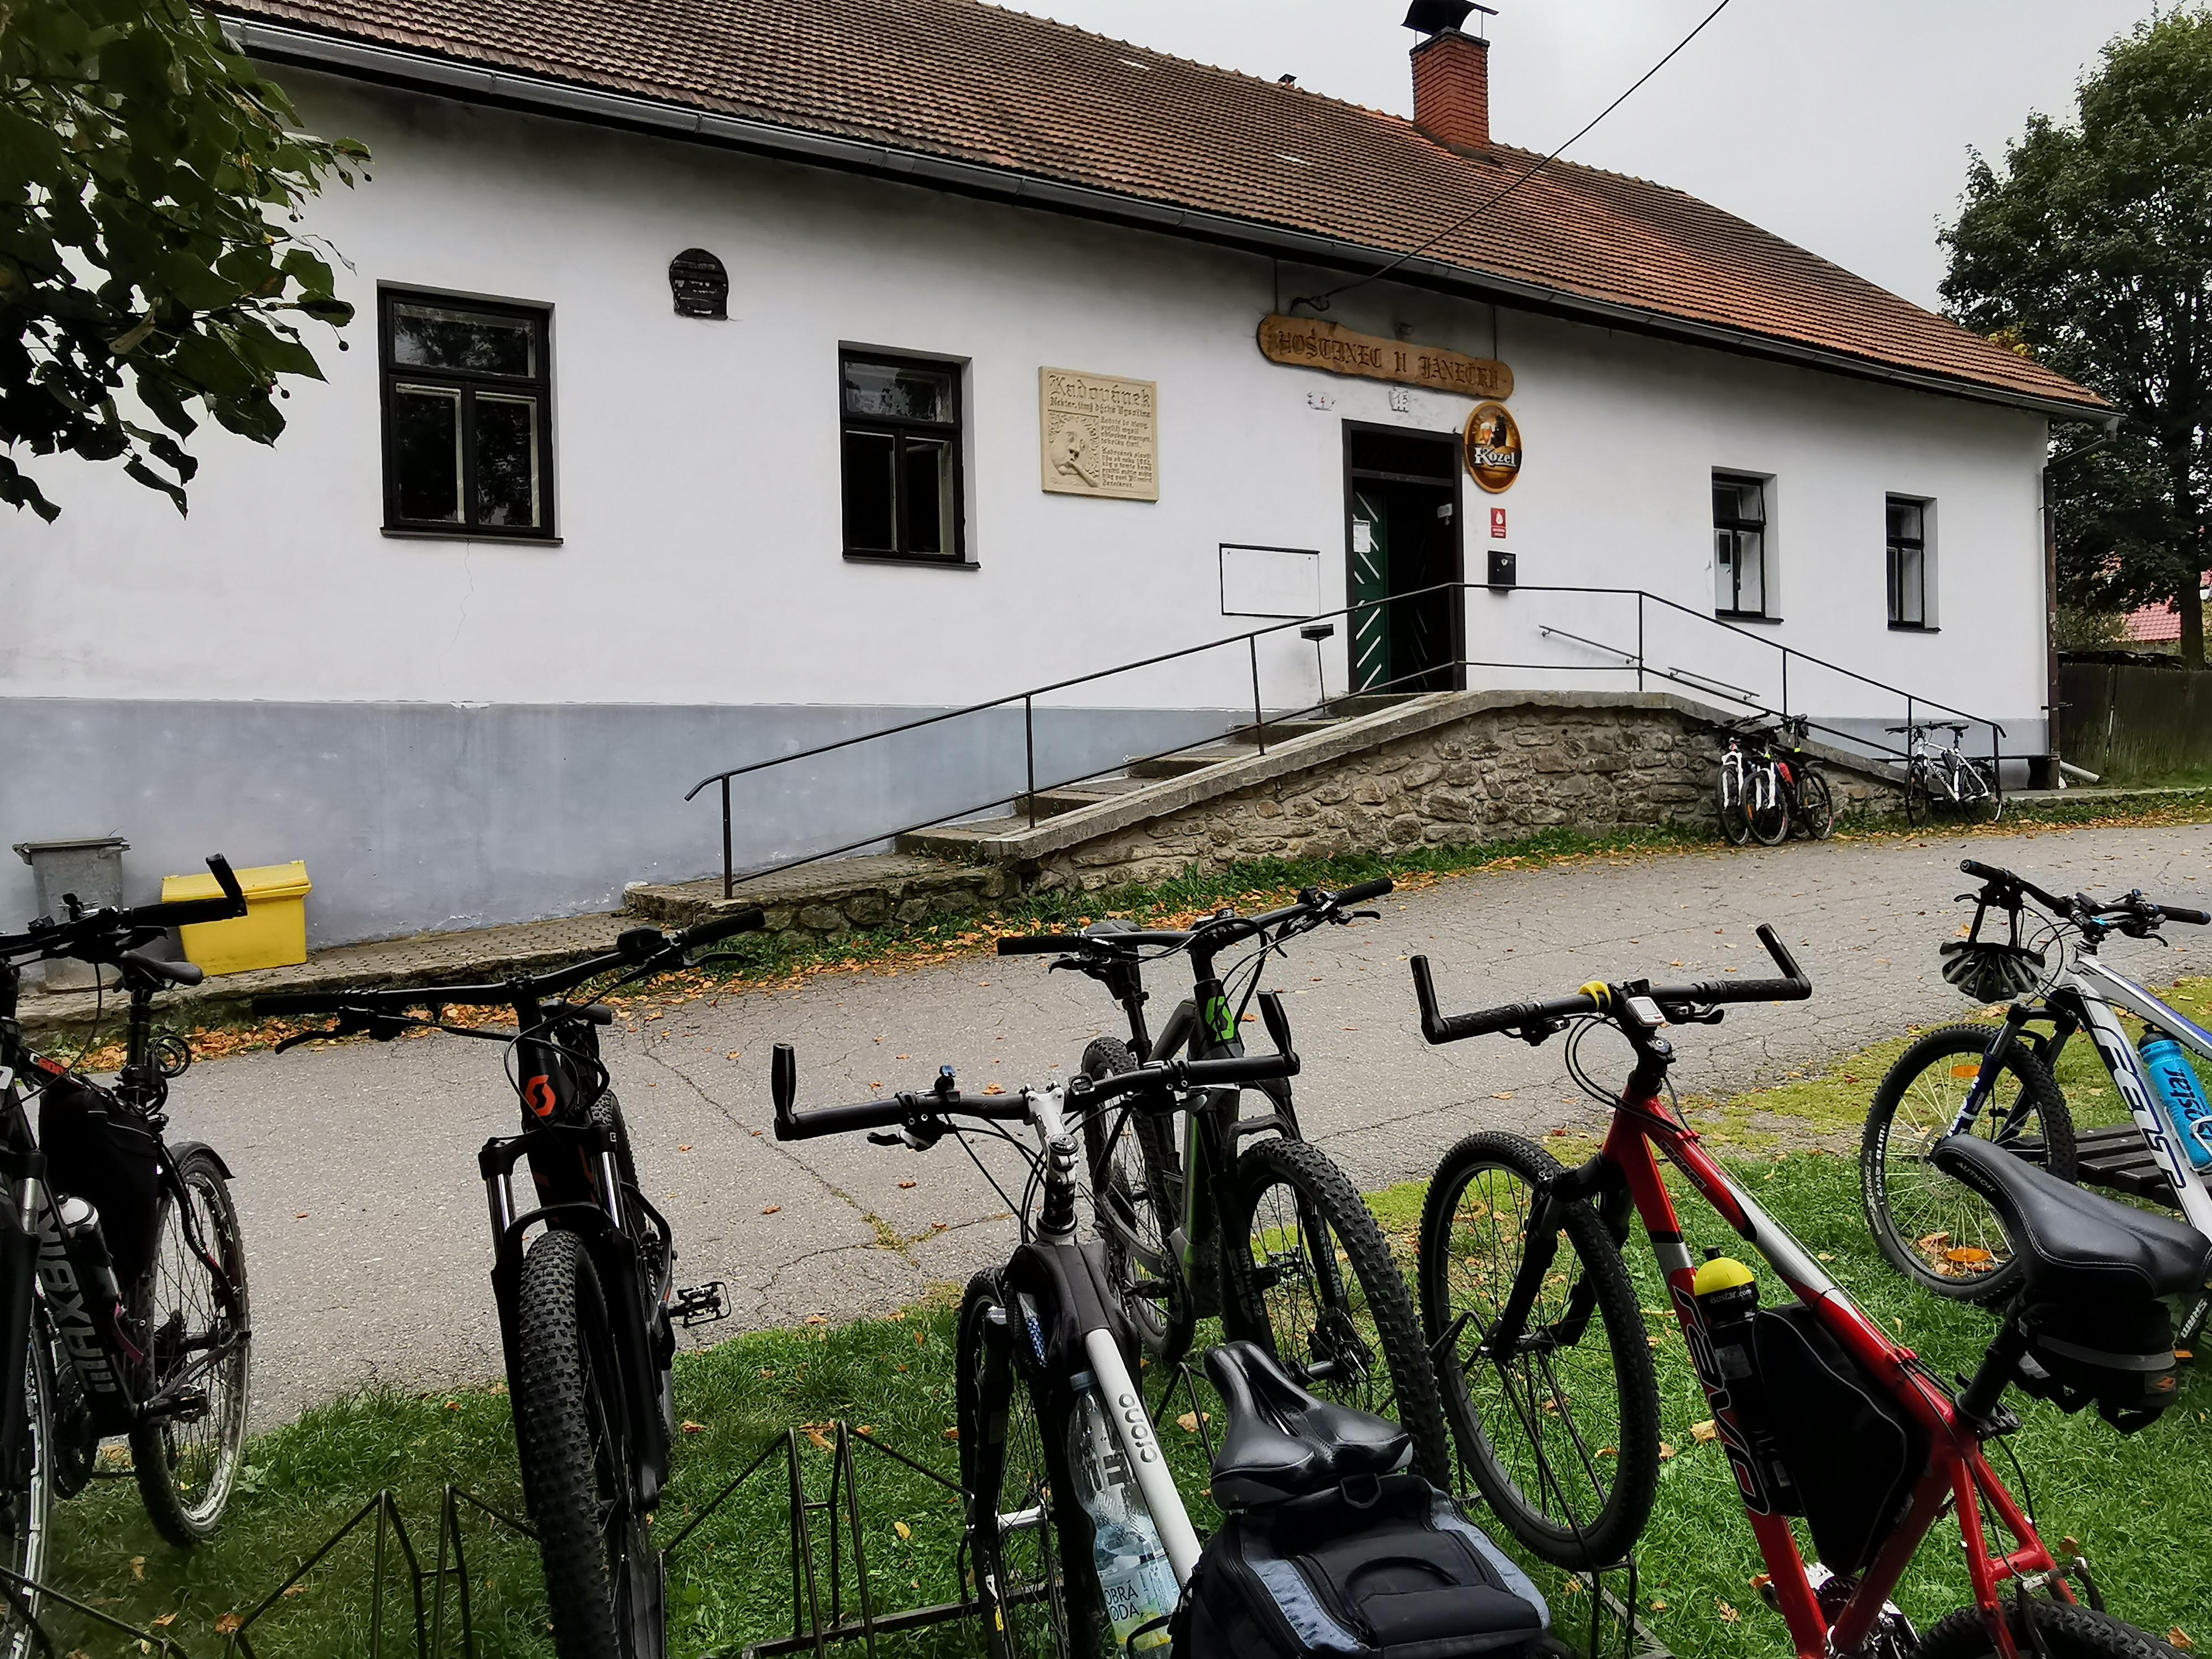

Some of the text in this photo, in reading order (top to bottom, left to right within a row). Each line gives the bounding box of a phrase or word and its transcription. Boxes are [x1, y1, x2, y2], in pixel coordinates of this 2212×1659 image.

[1474, 447, 1517, 467] Kozel
[2092, 1025, 2187, 1188] FELT
[1956, 1162, 1997, 1192] AUTHOR
